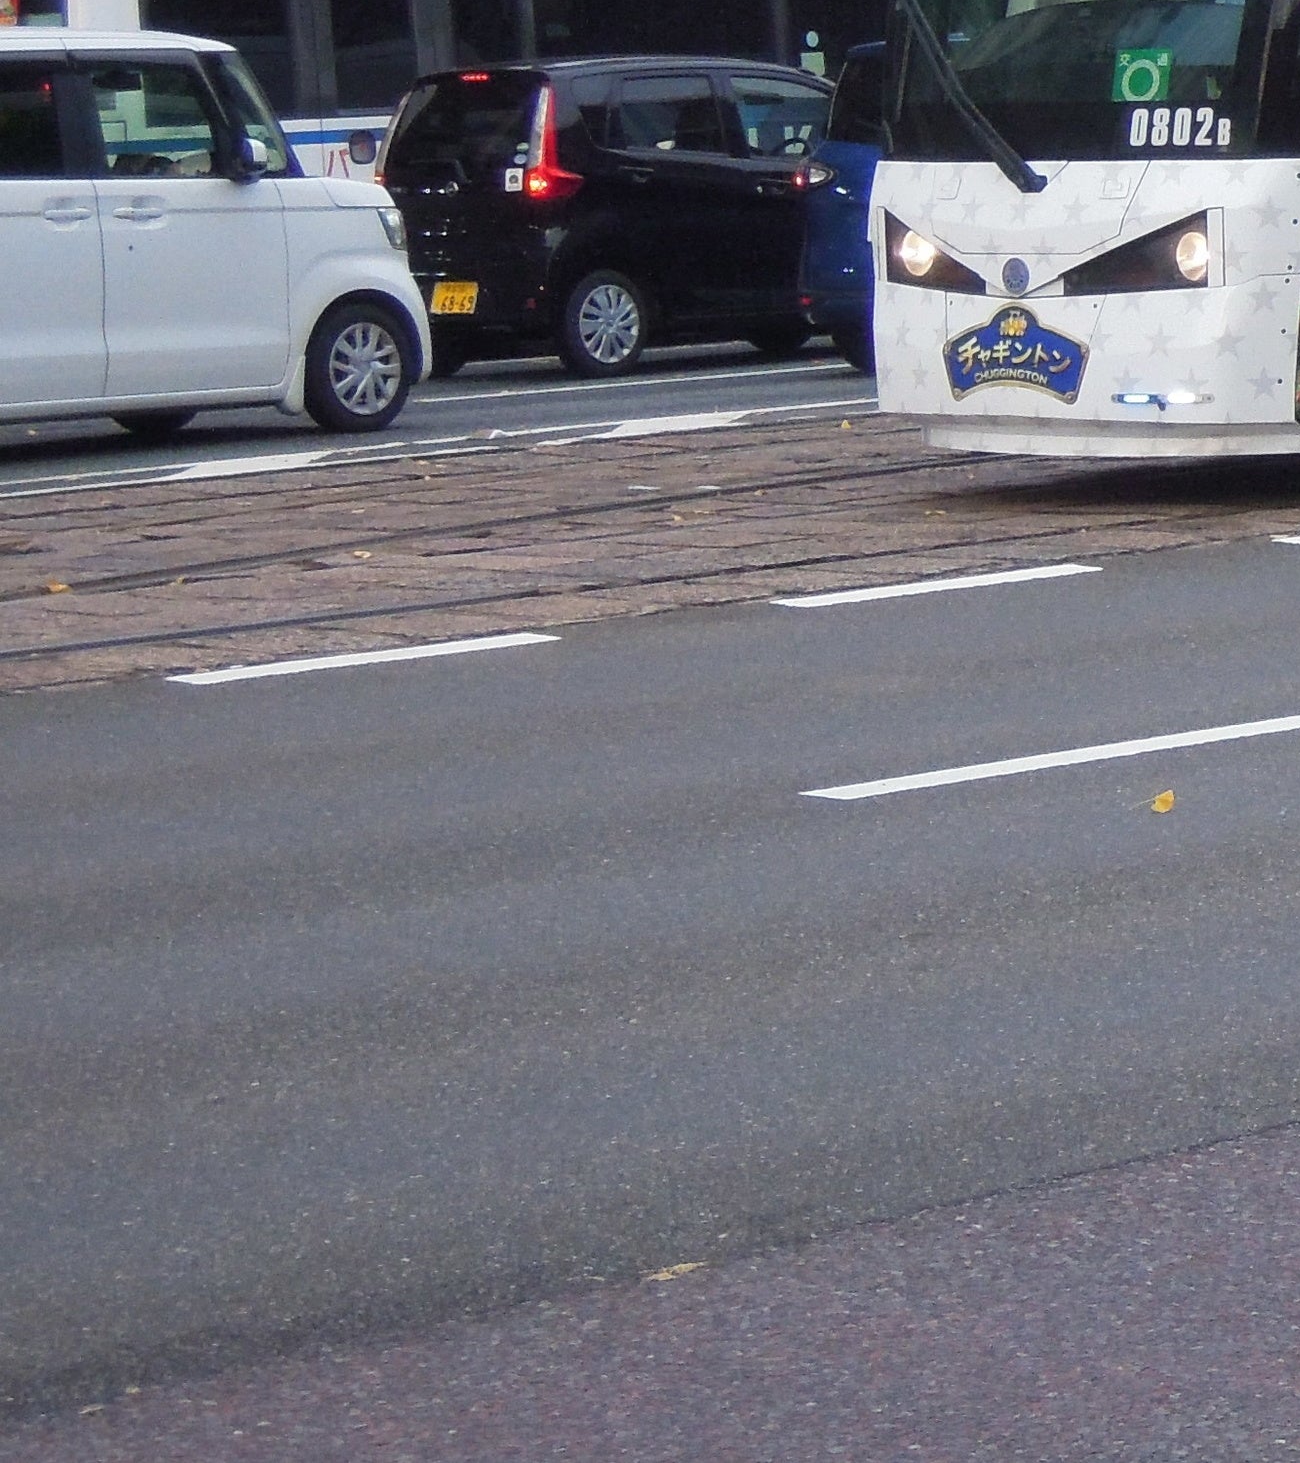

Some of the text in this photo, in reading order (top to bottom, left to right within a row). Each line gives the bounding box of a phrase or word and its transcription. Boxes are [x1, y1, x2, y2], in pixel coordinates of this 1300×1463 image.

[957, 336, 1072, 375] チャギントン
[974, 367, 1049, 385] CHUGGINGTON
